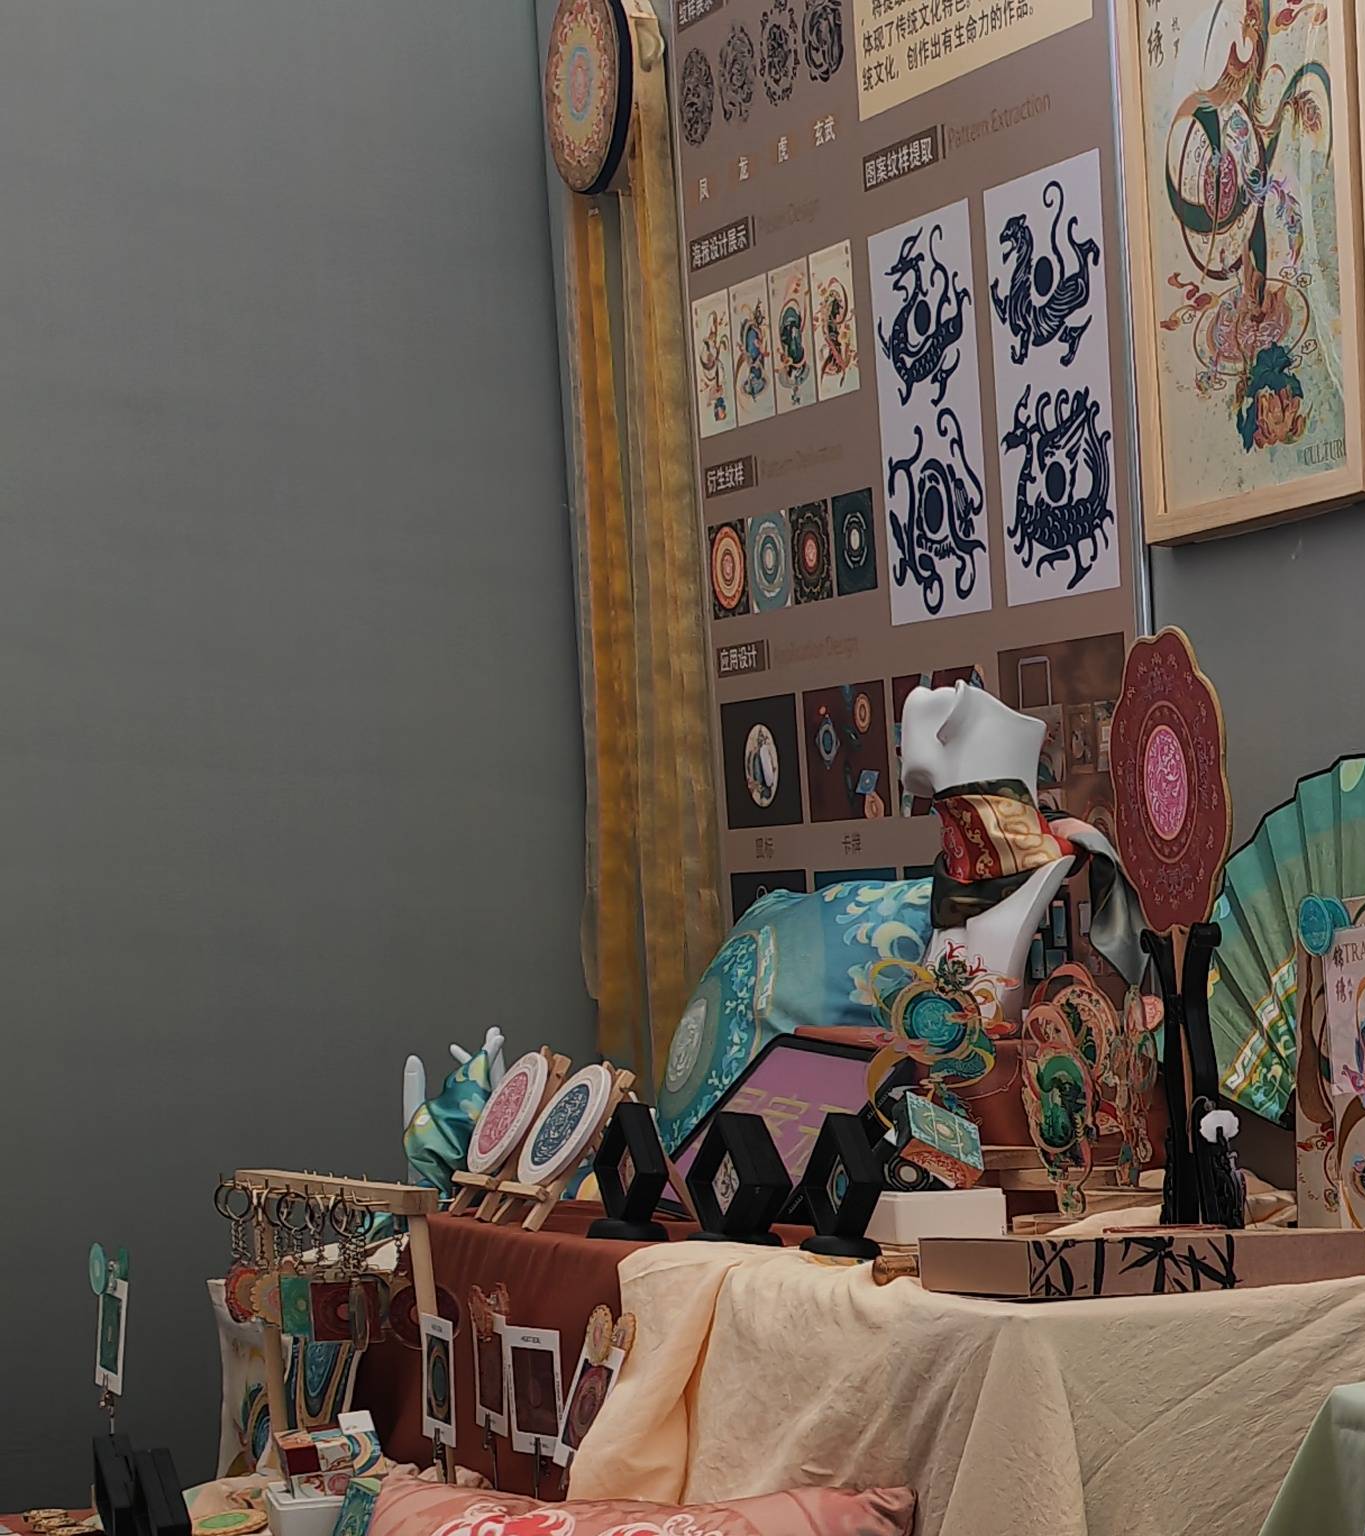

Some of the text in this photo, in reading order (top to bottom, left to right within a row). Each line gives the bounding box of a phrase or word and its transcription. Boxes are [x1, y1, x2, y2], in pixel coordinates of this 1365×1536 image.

[813, 115, 837, 147] 玄武
[990, 95, 1052, 133] Extraction
[865, 136, 934, 188] 图案纹样提取
[719, 643, 758, 672] 应用设计
